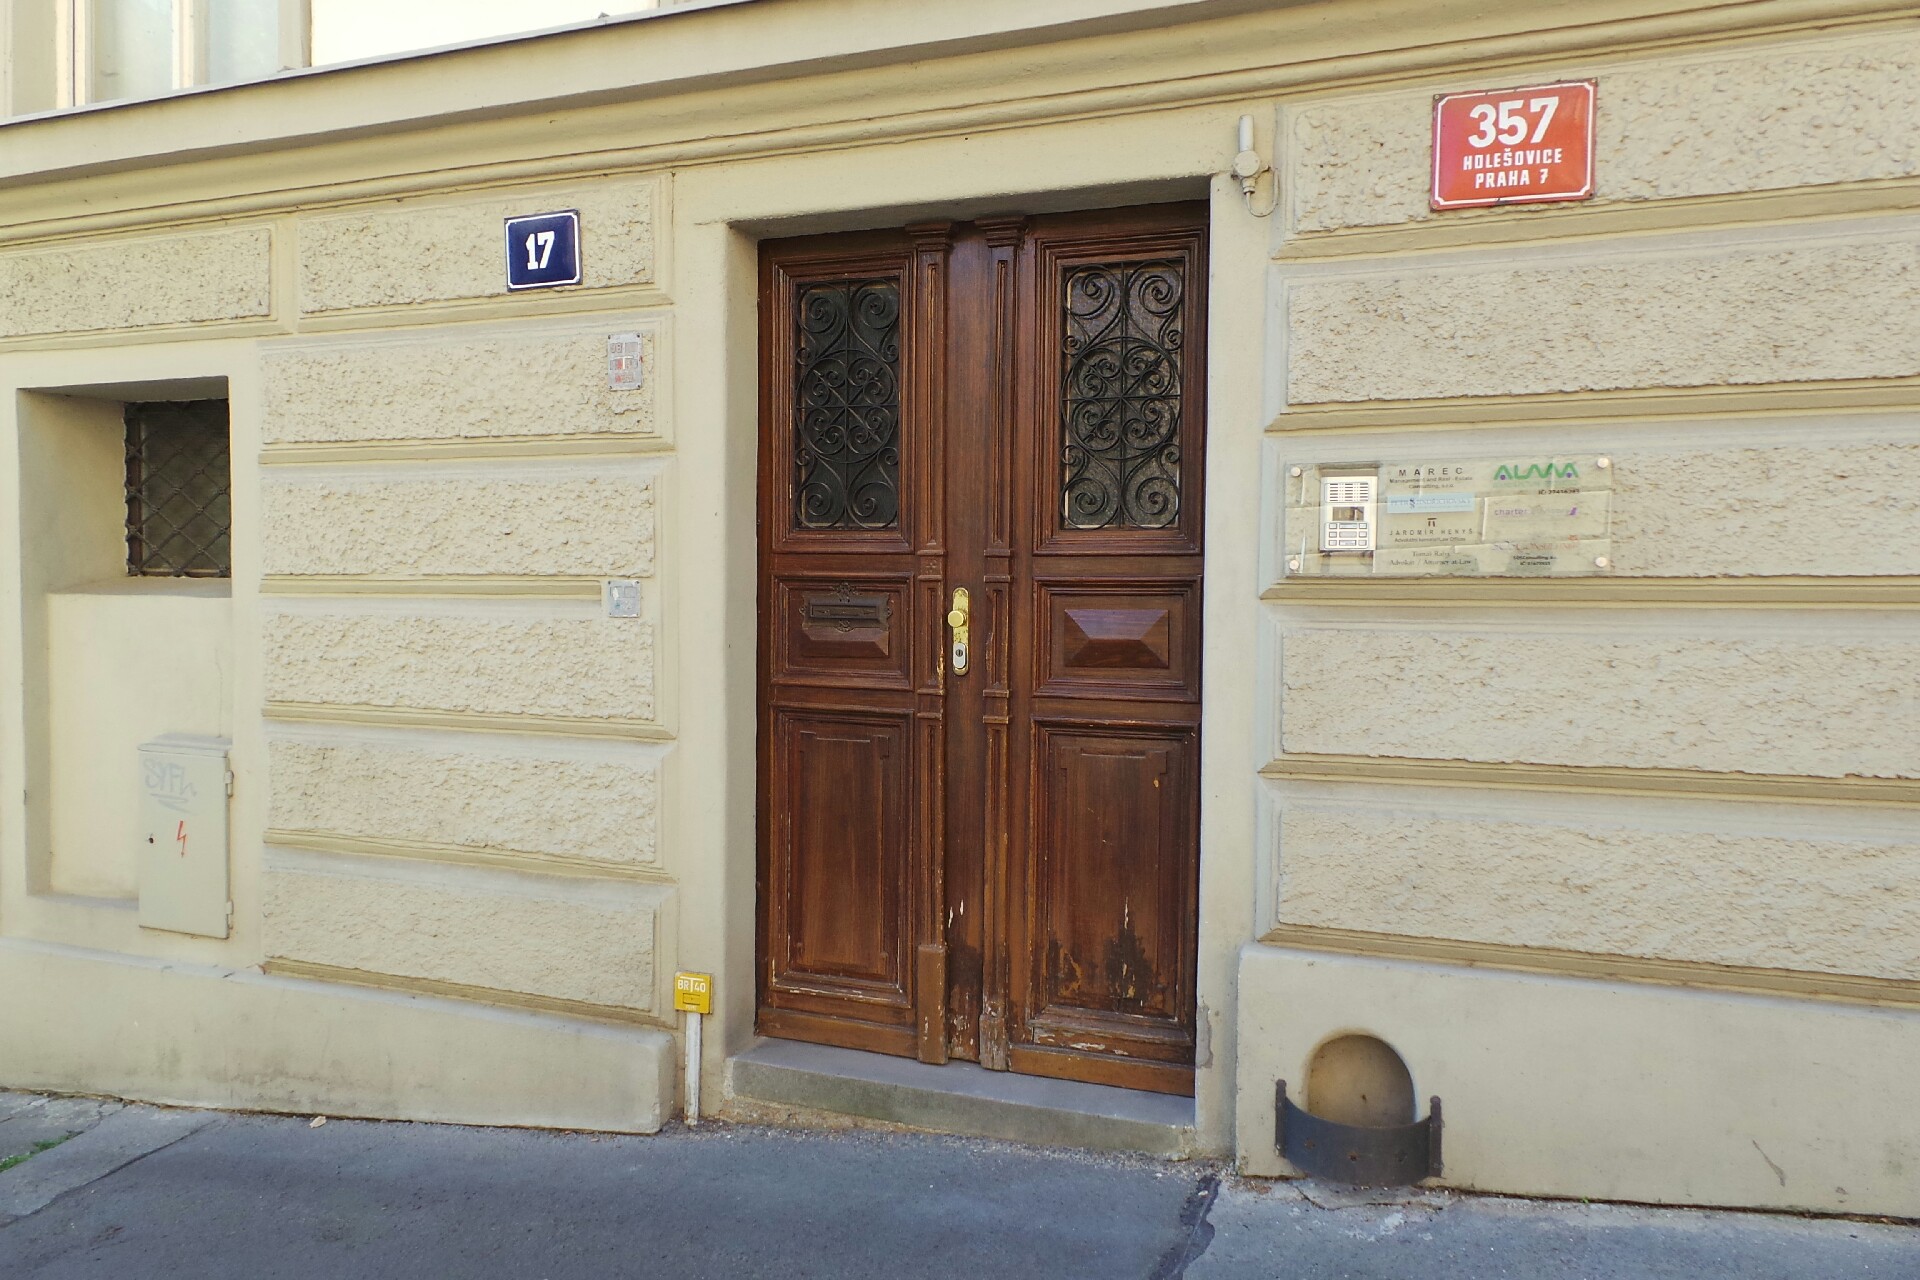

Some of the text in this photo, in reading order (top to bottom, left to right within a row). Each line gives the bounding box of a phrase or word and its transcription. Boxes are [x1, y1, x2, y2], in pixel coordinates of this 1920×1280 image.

[1468, 96, 1559, 148] 357
[1463, 148, 1562, 170] HOLEŠOVICE
[1475, 168, 1549, 189] PRAHA 7
[525, 230, 555, 270] 17
[1399, 467, 1463, 476] MAREC
